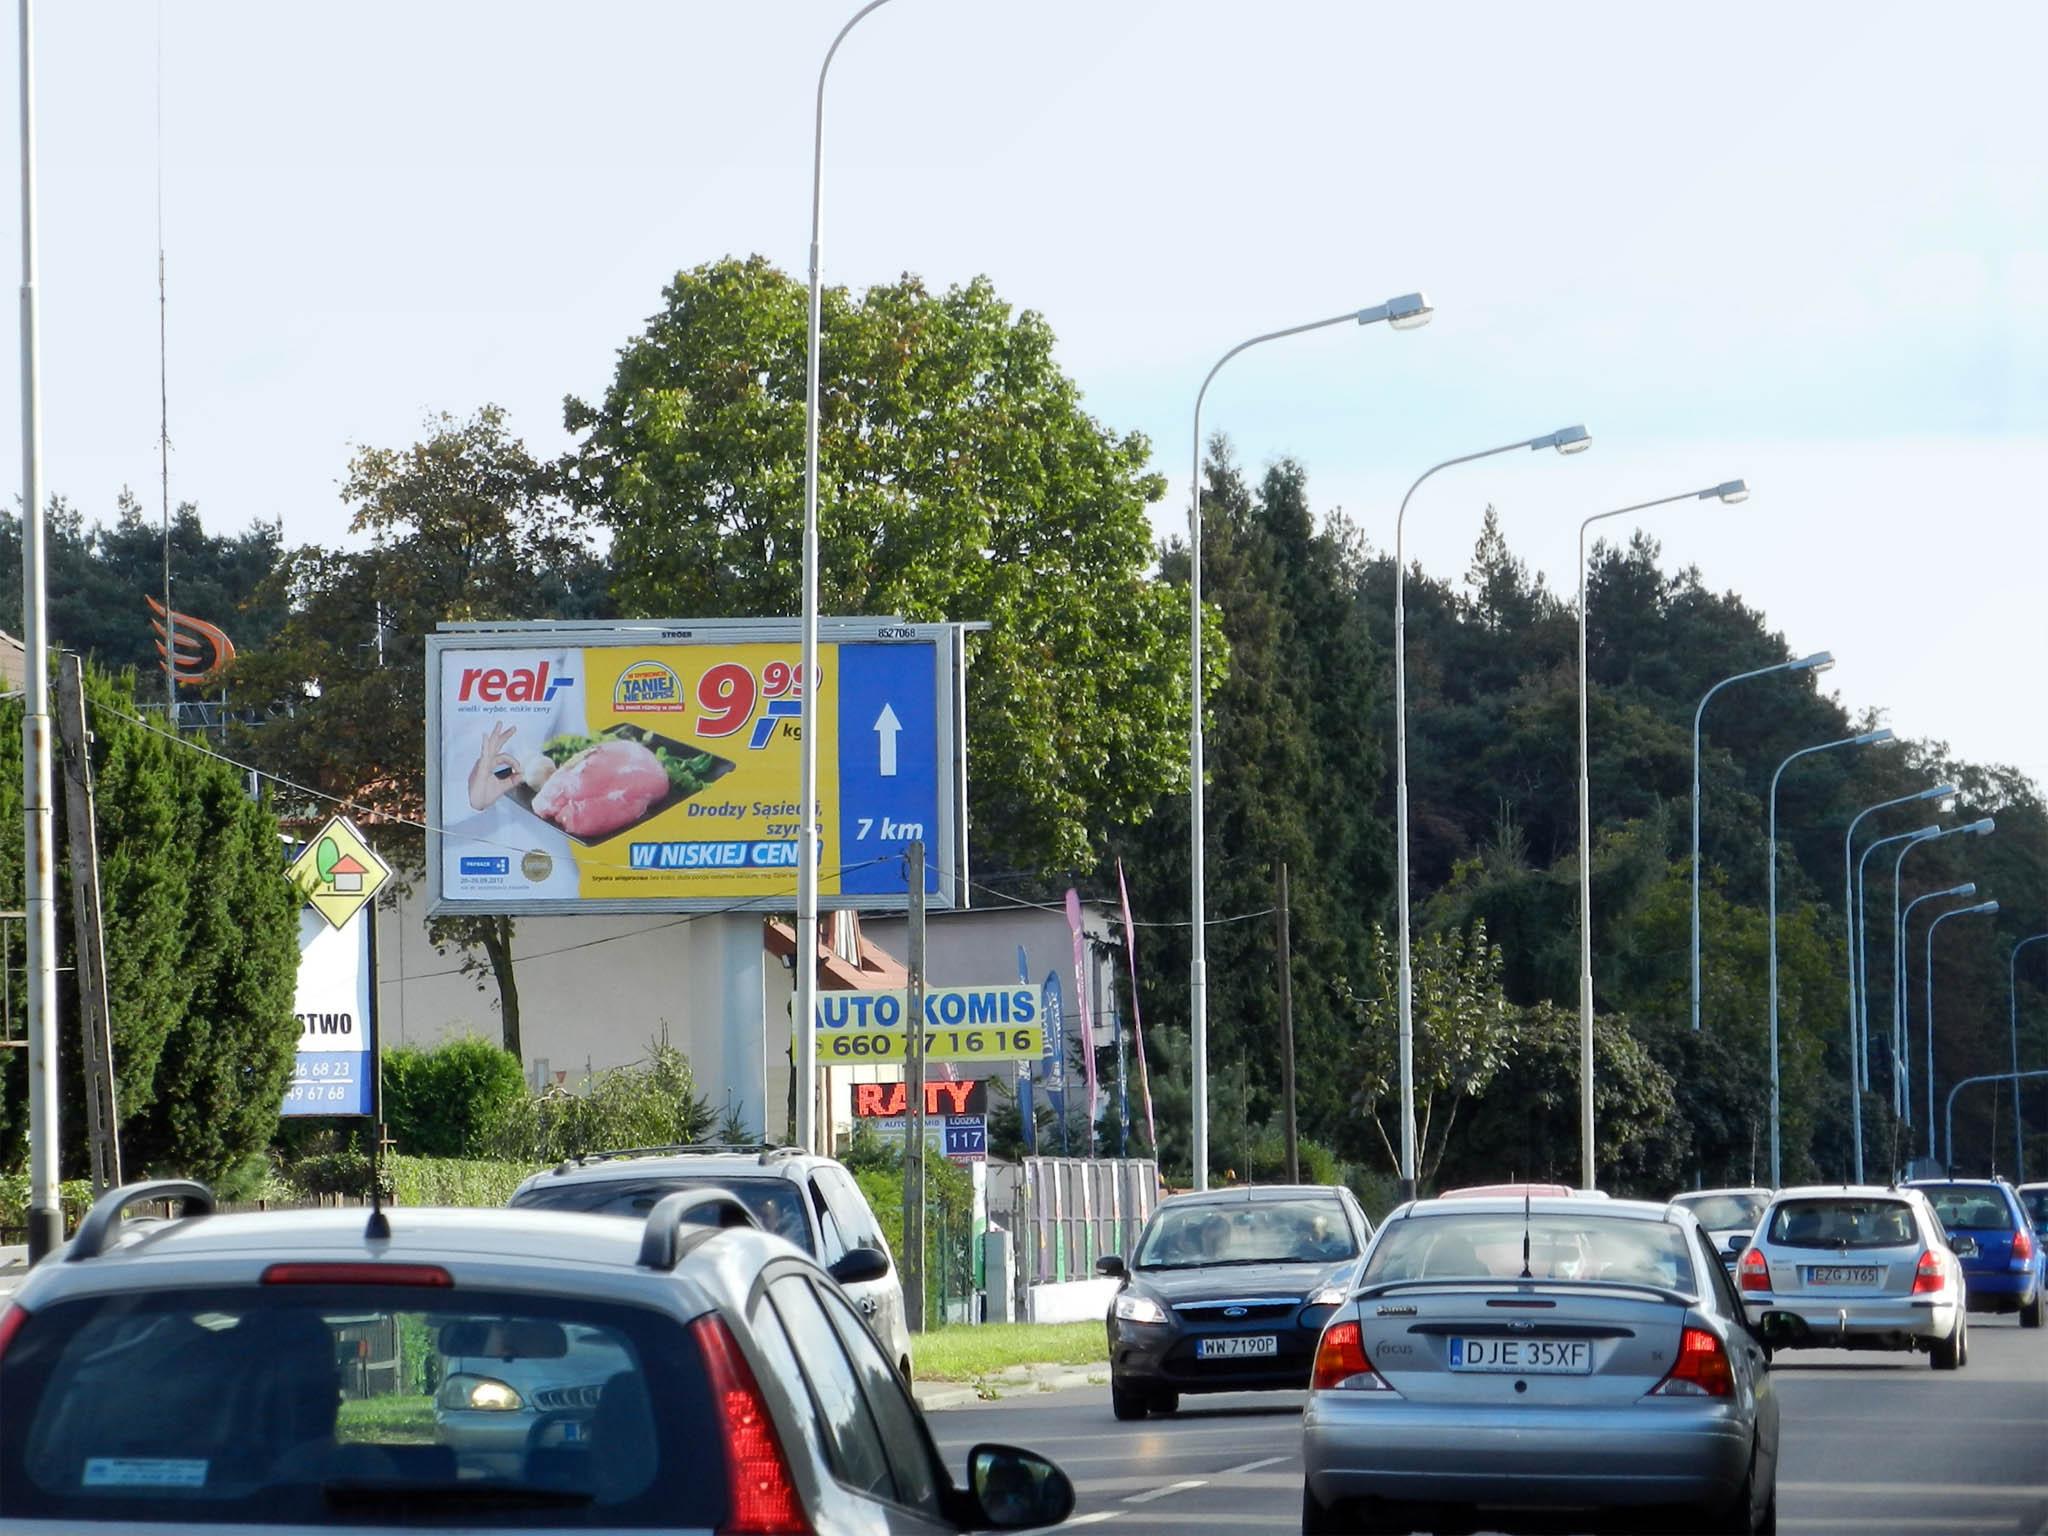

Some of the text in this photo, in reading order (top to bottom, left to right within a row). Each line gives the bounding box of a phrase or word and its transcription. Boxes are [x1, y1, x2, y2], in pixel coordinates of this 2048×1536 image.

[878, 628, 916, 639] 8527068
[623, 677, 674, 692] TANIEJ
[783, 723, 802, 741] kg
[688, 800, 822, 820] Drodzy Sąsiei,
[857, 817, 923, 840] 7 km
[632, 842, 821, 866] W NISKIEJ CEN
[913, 990, 1035, 1026] KOMIS
[833, 1034, 891, 1056] 660
[948, 1032, 984, 1052] 16
[996, 1030, 1031, 1050] 16
[312, 1062, 329, 1076] 68
[334, 1062, 349, 1076] 23
[308, 1086, 324, 1100] 67
[328, 1086, 345, 1100] 68
[950, 1132, 981, 1148] 117
[1815, 1269, 1842, 1281] EZG
[1205, 1337, 1274, 1355] WW 7190P
[1467, 1341, 1586, 1366] DJE 35XF
